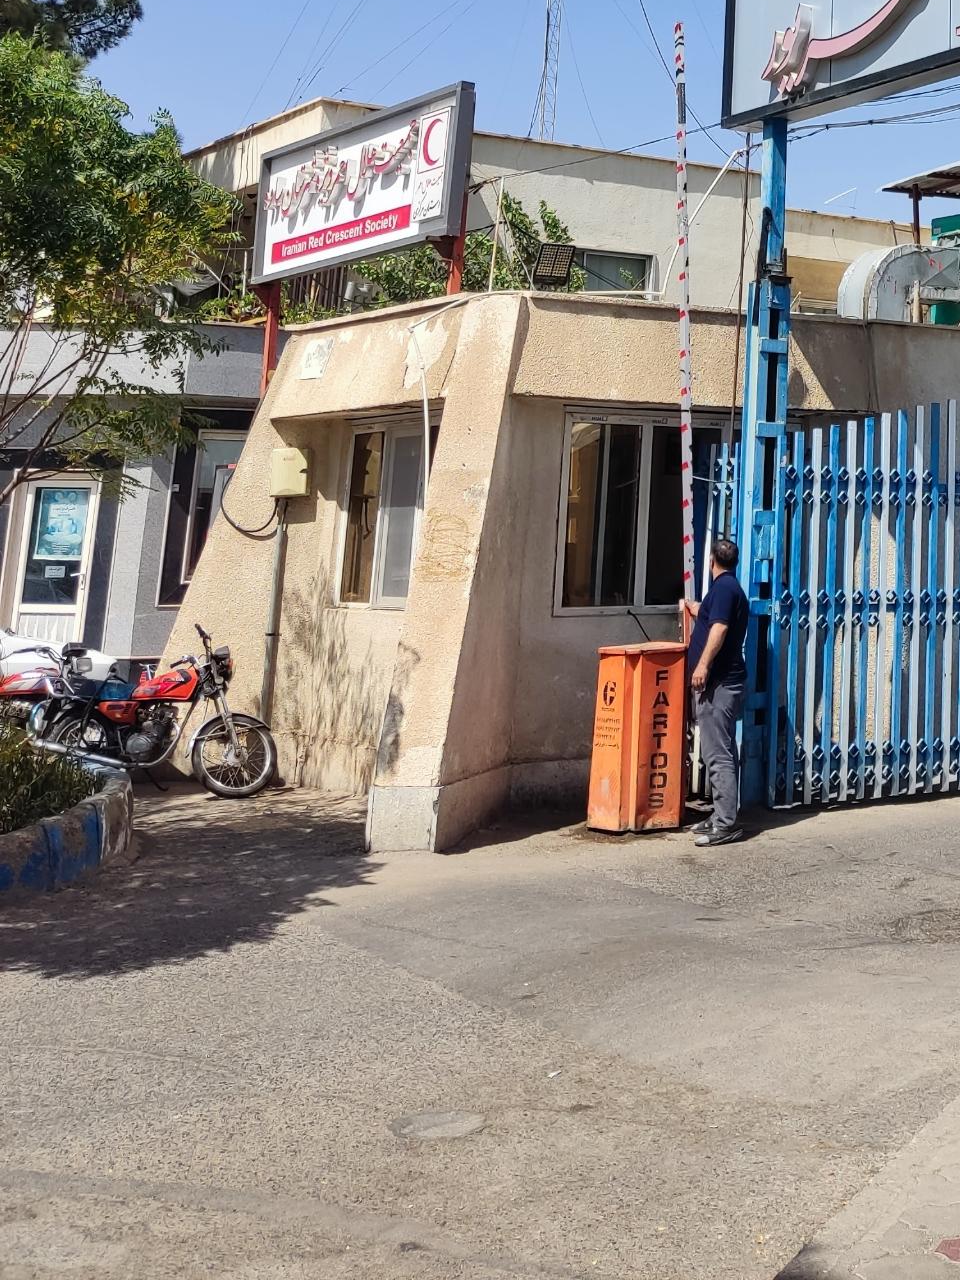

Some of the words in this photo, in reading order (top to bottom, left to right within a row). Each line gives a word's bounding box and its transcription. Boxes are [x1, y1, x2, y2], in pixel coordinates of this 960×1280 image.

[281, 240, 307, 257] Iranian
[308, 236, 324, 250] Red
[325, 224, 363, 244] Crescent
[364, 214, 398, 234] Society
[647, 669, 670, 809] FARTOOS
